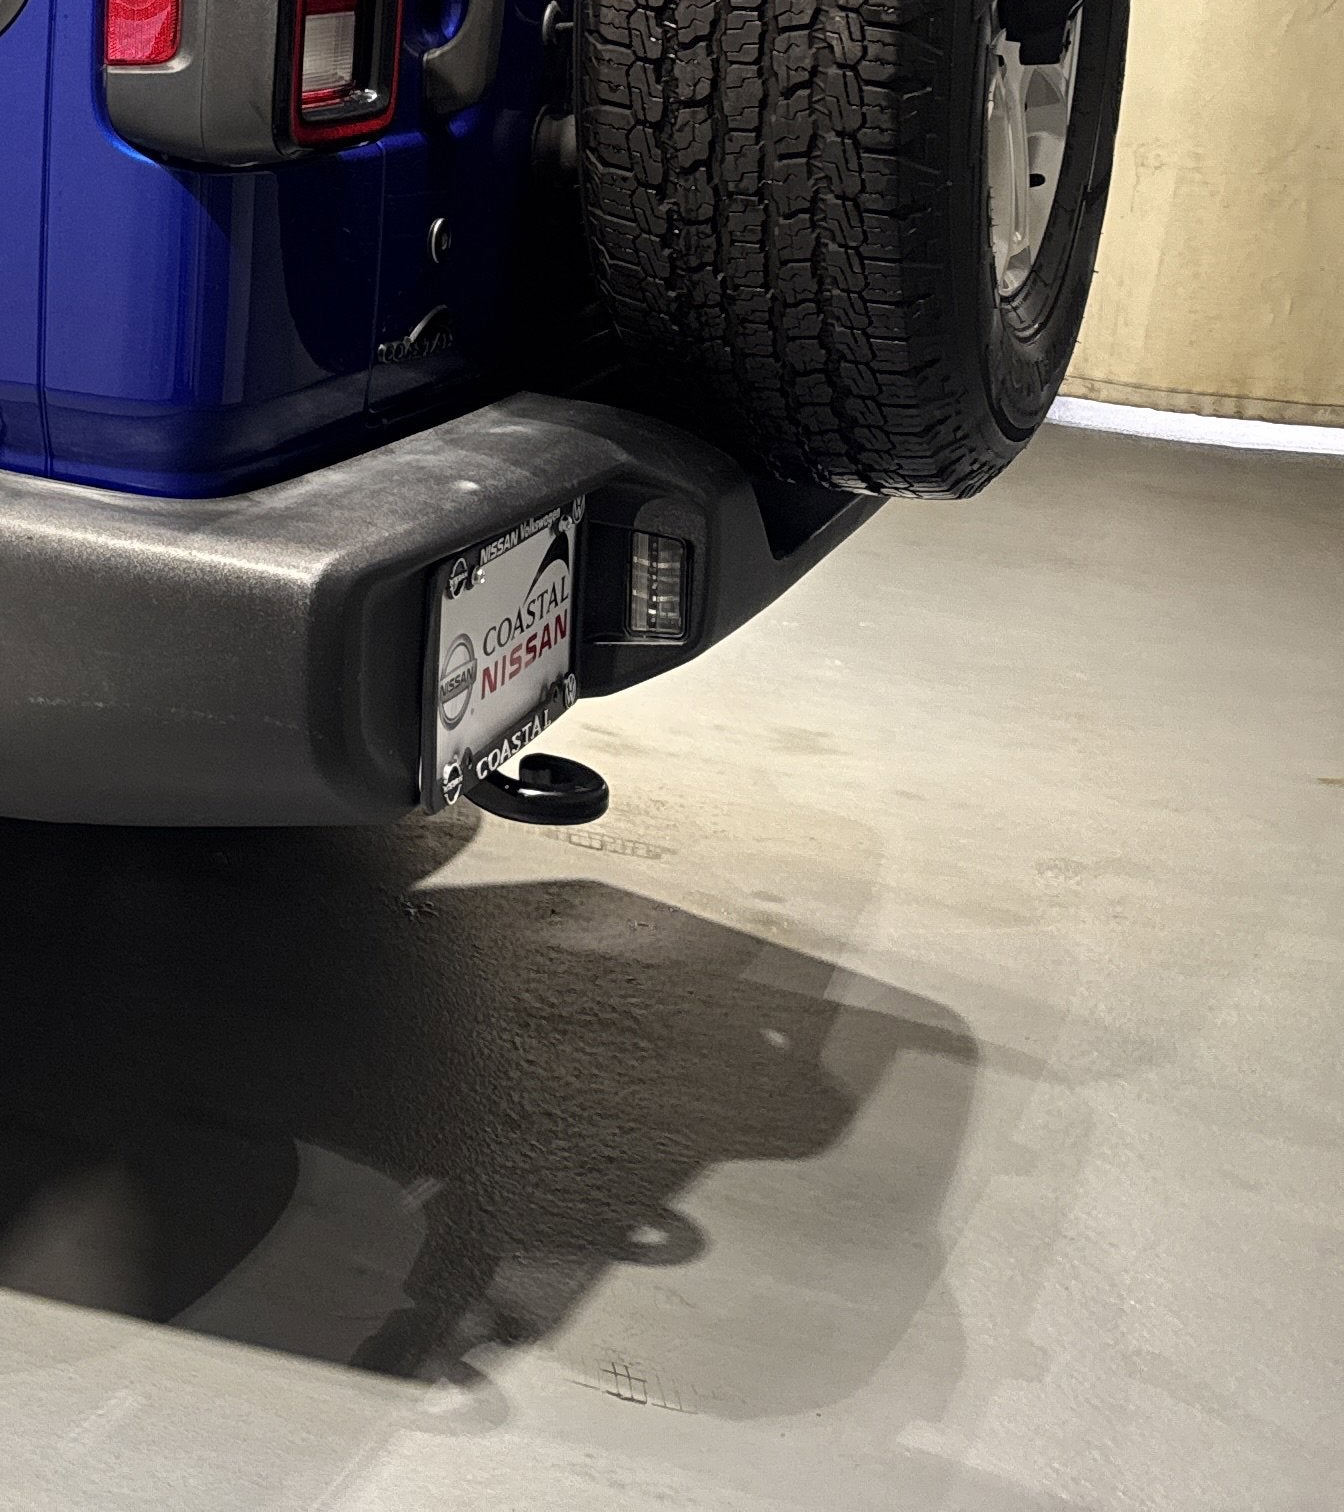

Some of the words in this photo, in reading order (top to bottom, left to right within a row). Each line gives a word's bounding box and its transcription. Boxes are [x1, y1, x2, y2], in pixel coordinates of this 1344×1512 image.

[480, 529, 519, 565] NISSAN
[520, 507, 561, 539] Volkswagen
[483, 575, 569, 656] COASTAL
[440, 665, 475, 697] NISSAN
[481, 608, 568, 700] NISSAN
[476, 709, 551, 779] COASTAL
